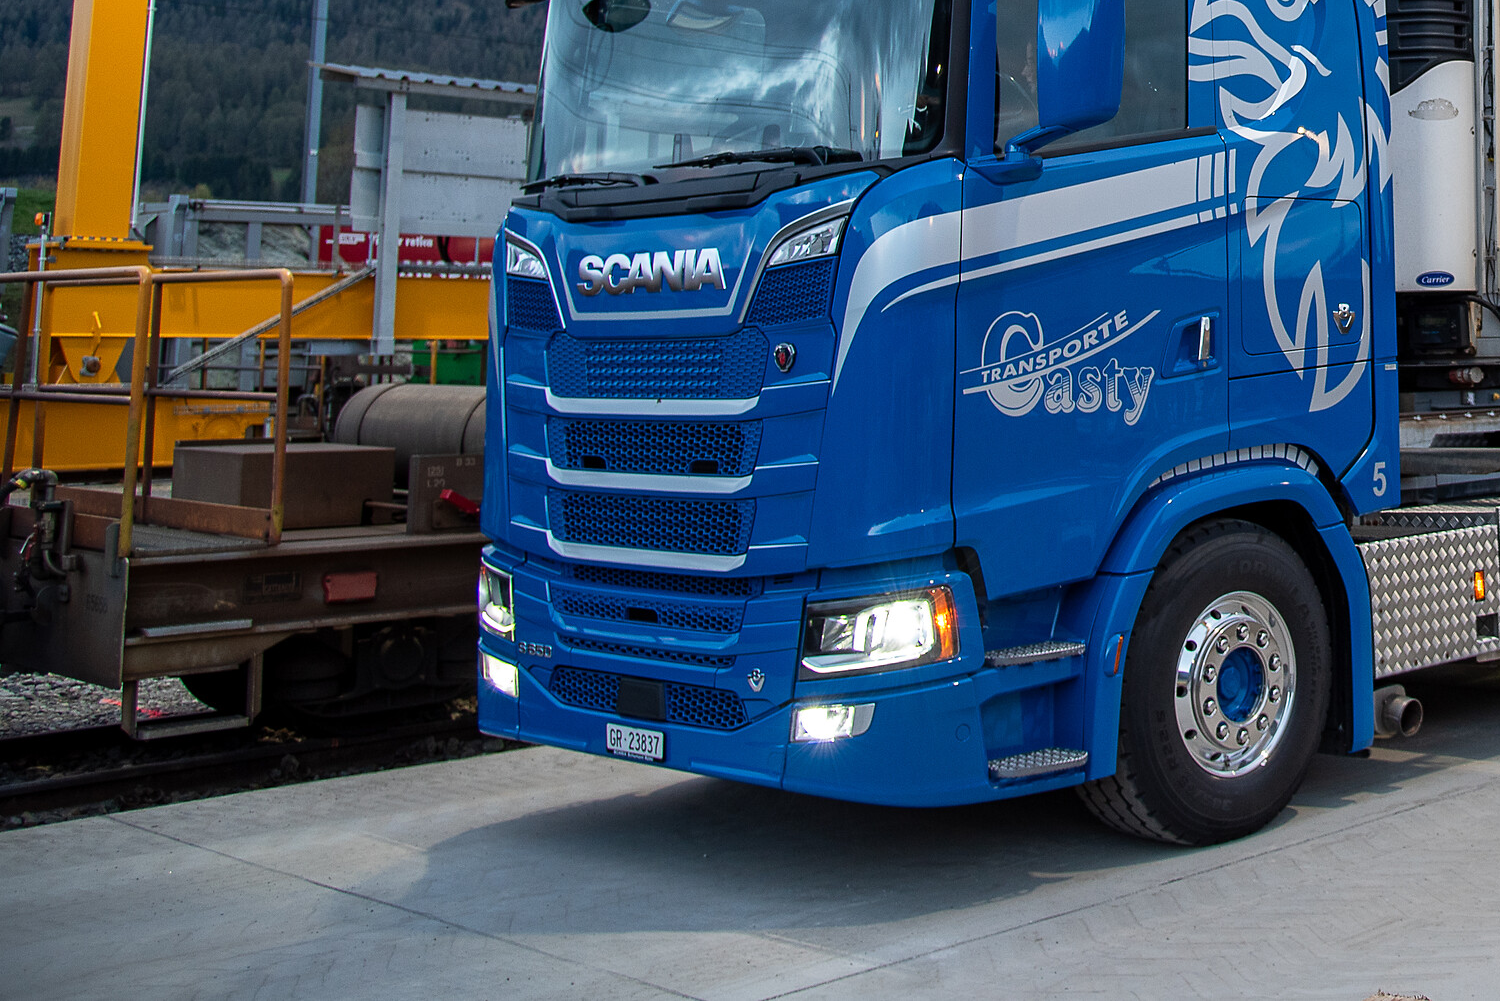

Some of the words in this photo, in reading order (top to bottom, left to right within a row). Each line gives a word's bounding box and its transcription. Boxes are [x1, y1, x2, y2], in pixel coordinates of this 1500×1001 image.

[577, 247, 727, 297] SCANIA
[1421, 275, 1450, 285] Carrier
[981, 309, 1129, 384] TRANSPORTE
[981, 310, 1155, 426] Casty
[1372, 461, 1387, 497] 5
